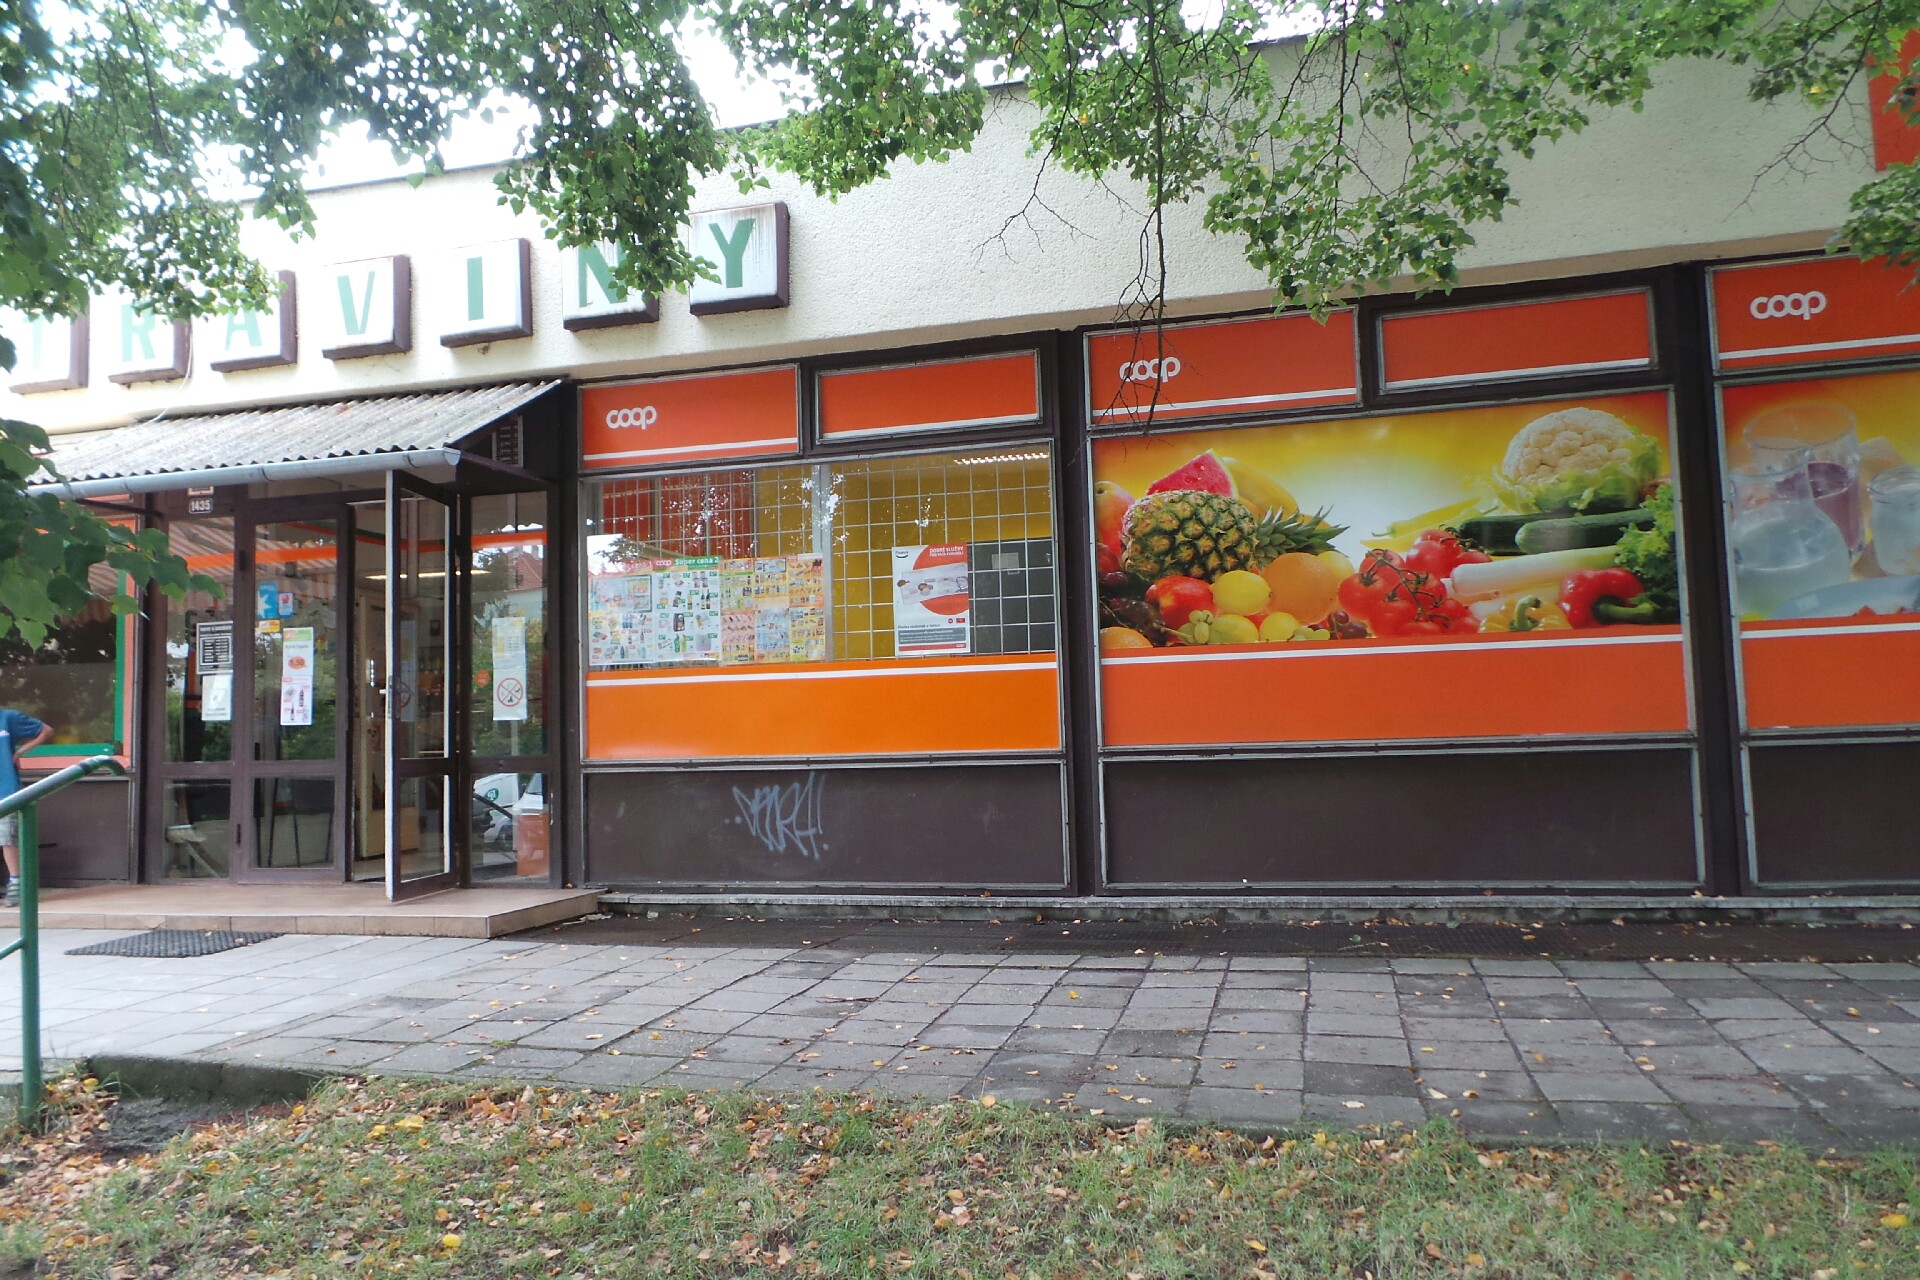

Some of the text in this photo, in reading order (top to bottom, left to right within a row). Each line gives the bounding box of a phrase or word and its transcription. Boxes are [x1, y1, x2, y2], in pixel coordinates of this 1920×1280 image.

[1750, 290, 1827, 321] coop
[1119, 356, 1181, 383] coop
[606, 405, 658, 430] coop
[191, 499, 211, 512] 1435
[675, 558, 695, 566] Super
[697, 557, 713, 565] cena
